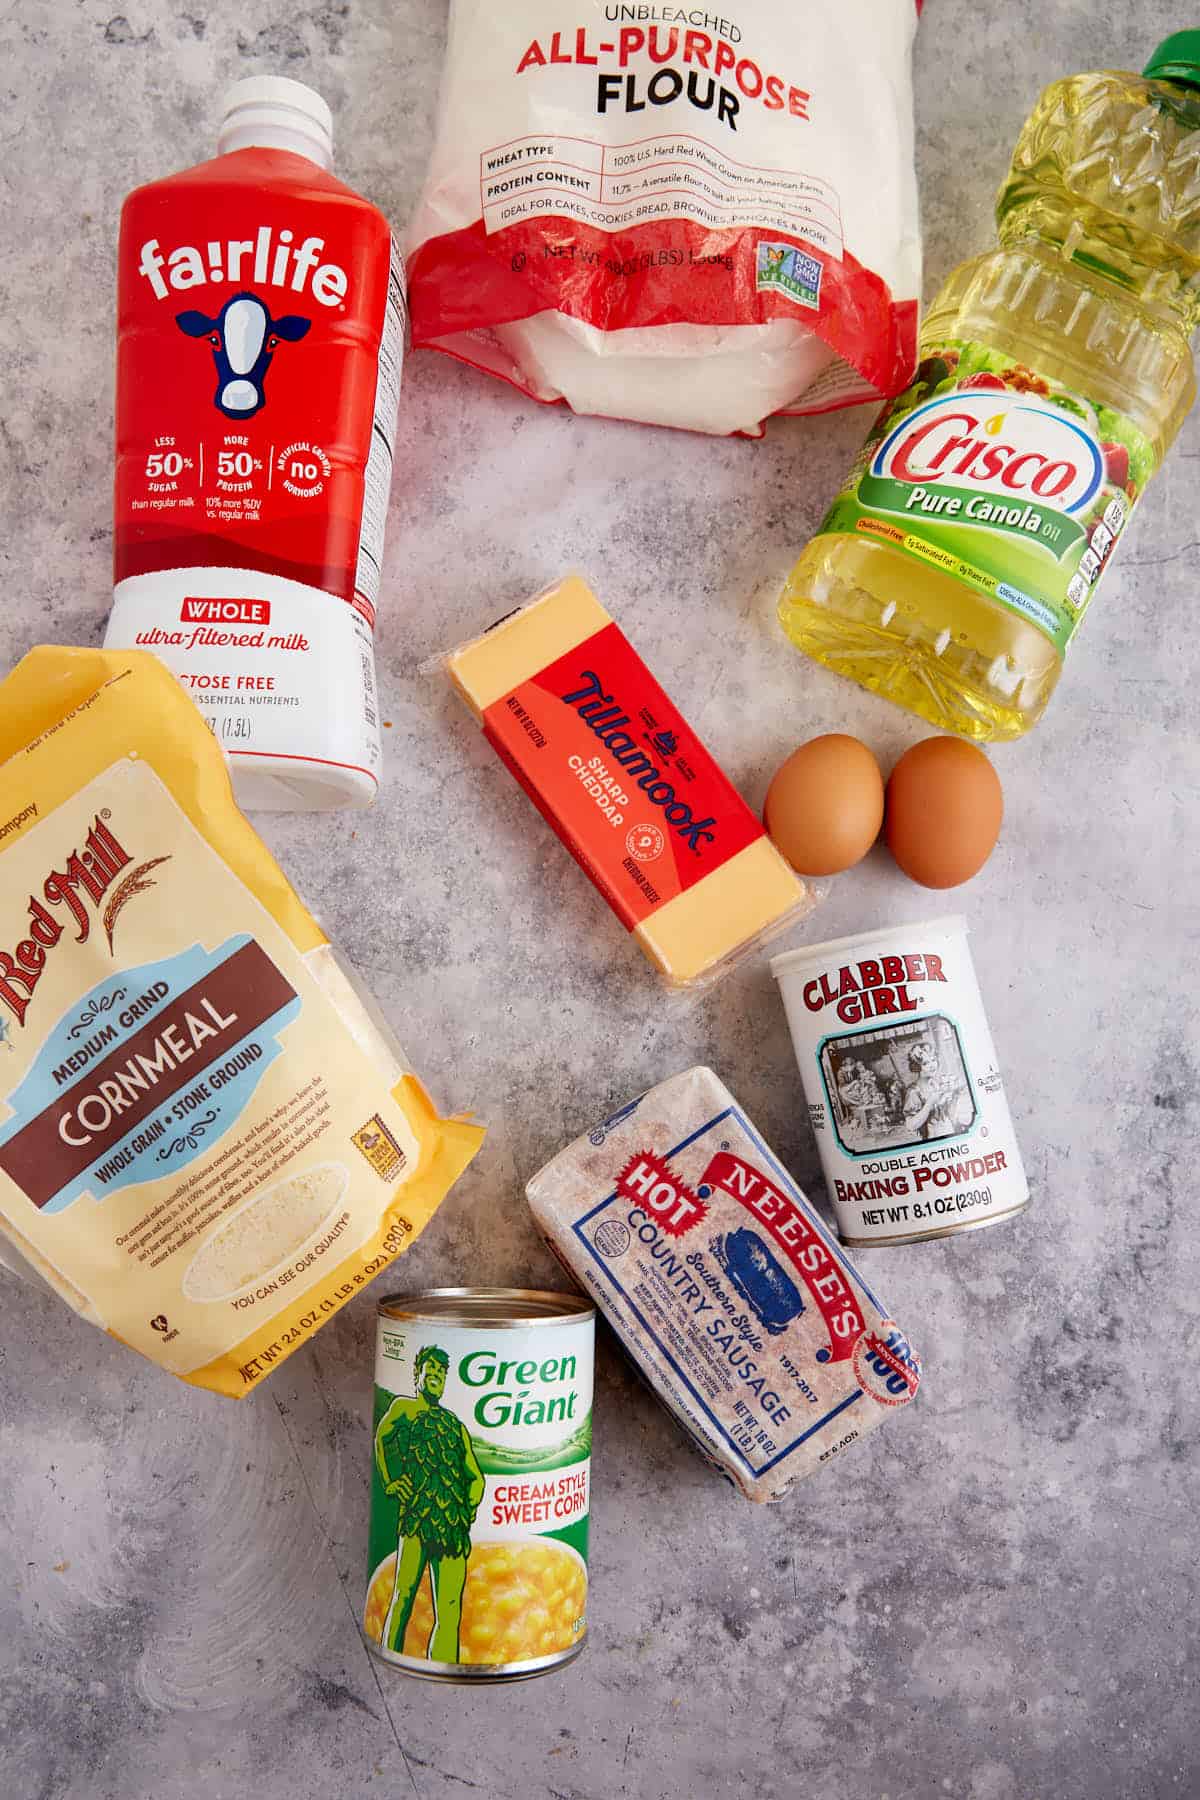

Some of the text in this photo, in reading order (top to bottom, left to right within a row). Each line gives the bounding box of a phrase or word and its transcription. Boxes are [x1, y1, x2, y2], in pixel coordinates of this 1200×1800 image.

[604, 3, 741, 43] UNBLEACHED
[516, 25, 810, 121] ALL-PURPOSE
[596, 67, 740, 131] FLOUR
[488, 146, 553, 169] WHEAT TYPE
[613, 156, 635, 166] 100%
[654, 145, 674, 156] Hard
[677, 144, 693, 156] Red
[718, 164, 742, 182] Grown
[756, 177, 799, 190] American
[487, 172, 591, 197] PROTEIN CONTENT
[683, 174, 702, 186] flour
[703, 183, 711, 192] to
[501, 203, 527, 219] IDEAL
[531, 199, 552, 209] FOR
[555, 200, 589, 218] CAKES,
[636, 203, 671, 217] BREAD,
[800, 226, 828, 244] MORE
[796, 254, 820, 274] NON
[155, 436, 176, 447] LESS
[224, 435, 249, 446] MORE
[277, 441, 331, 477] ARTIFICIAL GROWTH
[890, 413, 1077, 498] Crisco
[145, 452, 194, 477] 50%
[217, 452, 263, 477] 50%
[291, 461, 318, 480] no
[131, 496, 195, 510] than regular milk
[148, 481, 178, 492] SUGAR
[206, 497, 221, 508] 10%
[222, 499, 242, 509] more
[216, 479, 253, 492] PROTEIN
[218, 510, 243, 521] regular
[245, 511, 260, 520] milk
[906, 487, 962, 517] Pure
[965, 497, 1043, 533] Canola
[886, 527, 902, 540] Free
[912, 540, 943, 560] Saturated
[187, 601, 262, 621] WHOLE
[135, 626, 310, 651] ultra-filtered milk
[180, 675, 275, 690] TOSE FREE
[249, 695, 300, 706] NUTRIENTS
[222, 717, 252, 739] (1.5L)
[560, 670, 716, 851] Tillamook
[568, 755, 624, 828] CHEDDAR
[588, 756, 630, 808] SHARP
[0, 802, 38, 840] ompany
[639, 835, 651, 848] 9
[621, 856, 660, 904] CHEDDAR CHEESE
[0, 815, 134, 1028] Red Mill
[802, 953, 948, 1013] CLABBER
[836, 985, 918, 1025] GIRL
[50, 978, 171, 1085] MEDIUM GRIND
[51, 988, 239, 1153] CORNMEAL
[95, 1041, 264, 1184] WHOLE GRAIN STONE GROUND
[833, 1151, 1008, 1202] BAKING POWDER
[861, 1144, 970, 1175] DOUBLE ACTING
[627, 1161, 698, 1225] HOT
[862, 1186, 993, 1226] NET WT 8.1 OZ (230g)
[724, 1162, 860, 1338] NEESE'S
[230, 1294, 257, 1311] YOU
[254, 1279, 279, 1301] CAN
[277, 1268, 296, 1286] SEE
[294, 1251, 317, 1273] OUR
[259, 1340, 284, 1364] WT
[280, 1325, 302, 1346] 24
[298, 1307, 322, 1330] OZ
[318, 1296, 335, 1313] (1
[334, 1281, 354, 1301] LB
[353, 1272, 366, 1285] 8
[363, 1251, 389, 1276] OZ)
[381, 1215, 414, 1256] 680g
[628, 1208, 791, 1427] COUNTRY SAUSAGE
[686, 1251, 765, 1353] Southern Style
[458, 1350, 577, 1388] Green
[779, 1354, 819, 1403] 1917-2017
[474, 1390, 577, 1429] Giant
[731, 1399, 778, 1456] NET WT. 16 OZ
[729, 1422, 757, 1453] (1 LB.)
[494, 1471, 586, 1504] CREAM STYLE
[492, 1490, 586, 1526] SWEET CORN
